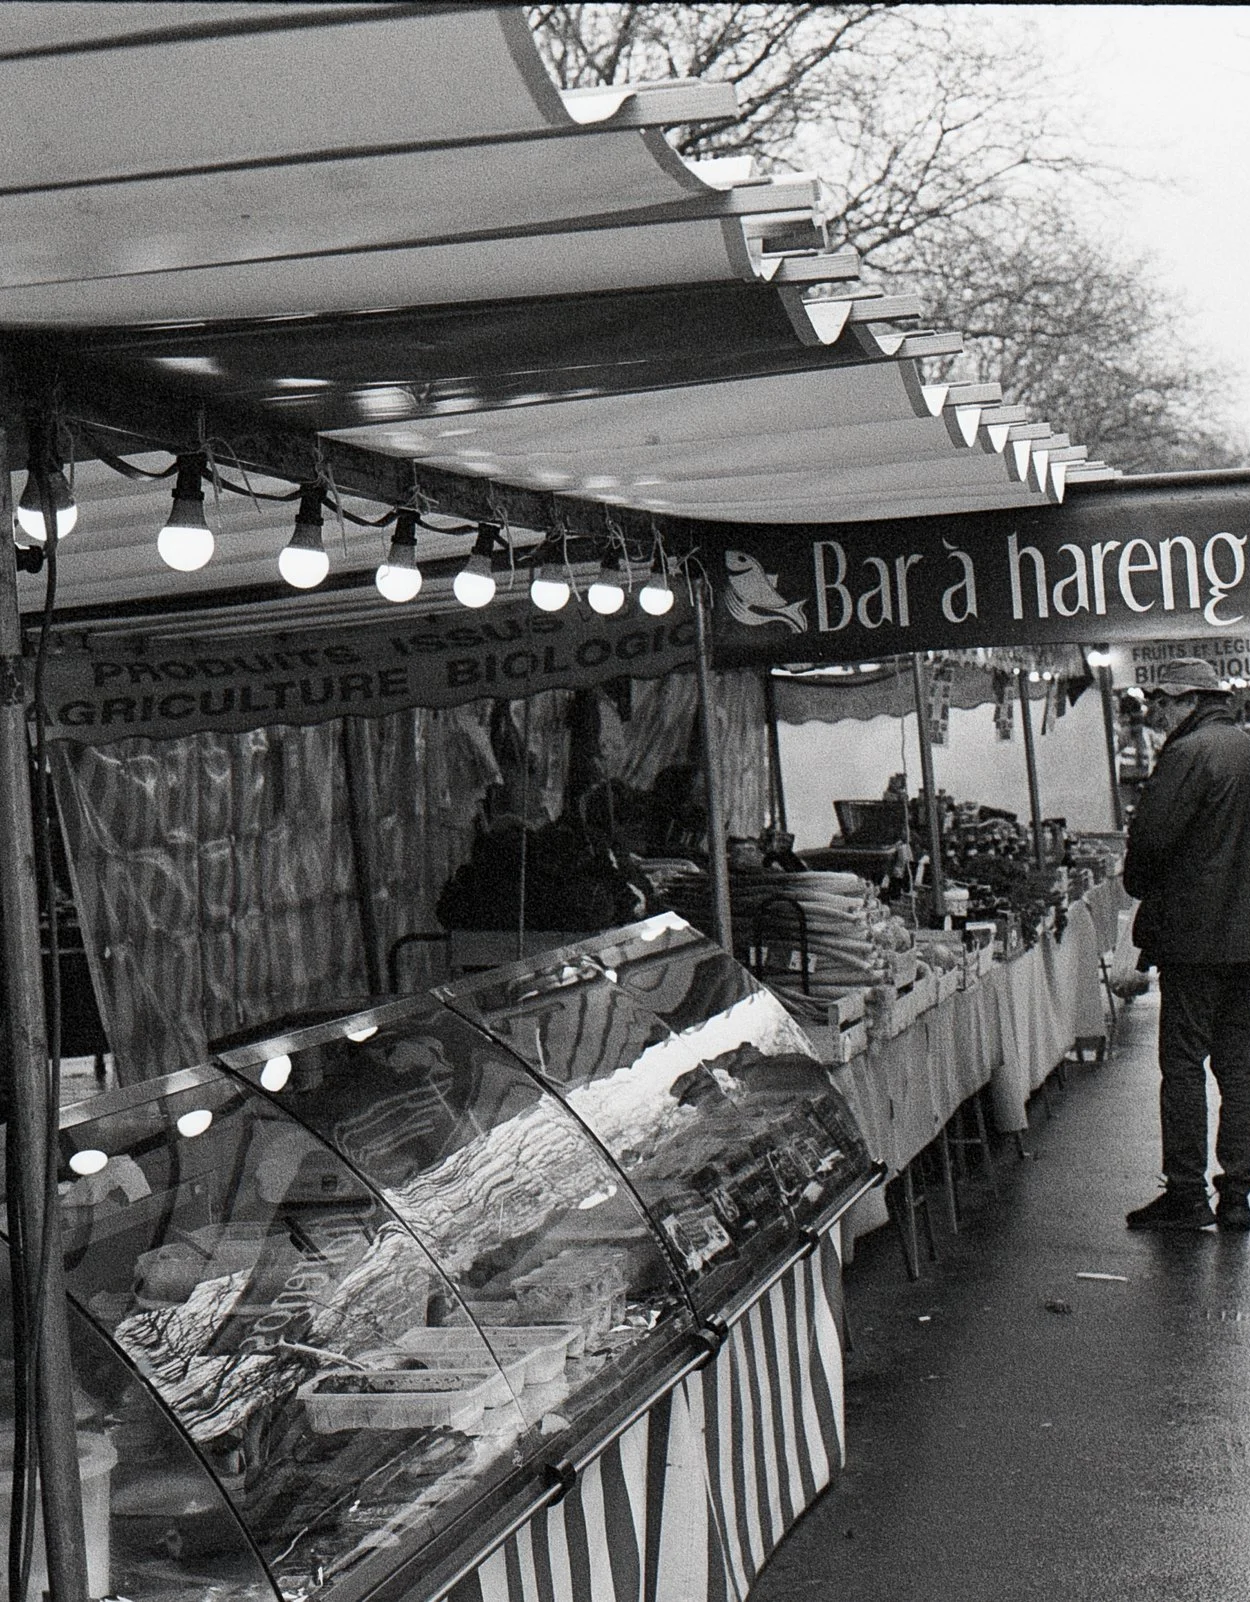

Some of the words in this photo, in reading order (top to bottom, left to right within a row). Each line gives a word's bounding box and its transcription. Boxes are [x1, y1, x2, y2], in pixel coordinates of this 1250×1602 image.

[812, 539, 924, 632] Bar
[941, 536, 979, 624] à
[91, 644, 361, 687] PRODUITS
[388, 614, 565, 656] ISSUS
[1132, 643, 1188, 662] FRUITS
[25, 667, 408, 726] AGRICULTURE
